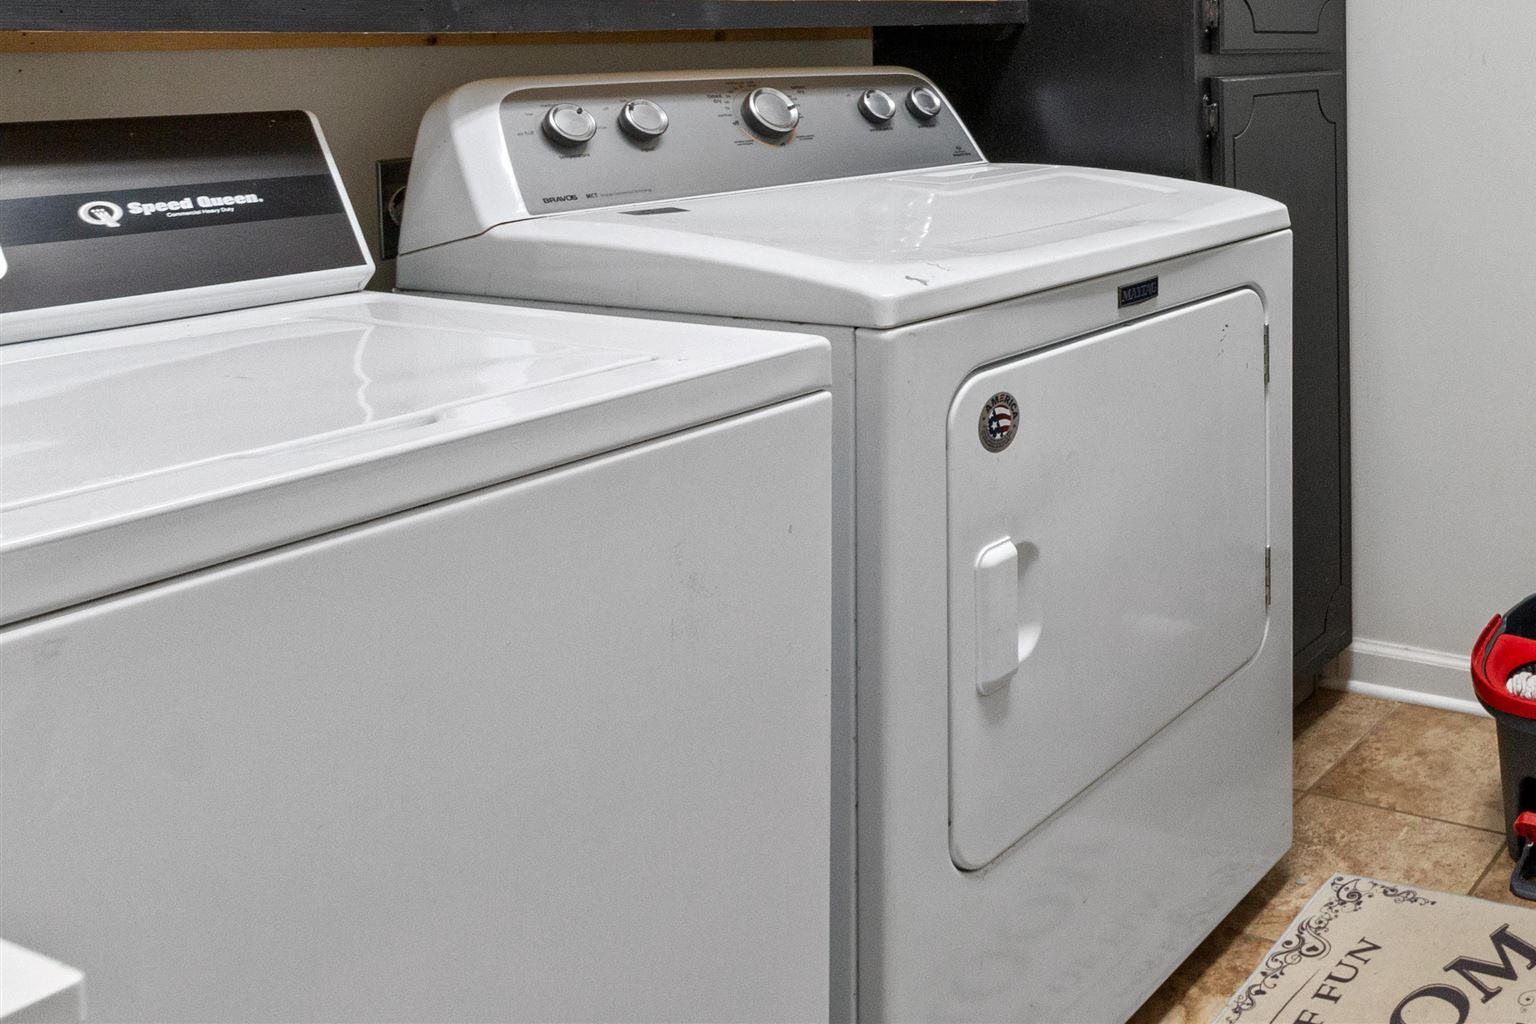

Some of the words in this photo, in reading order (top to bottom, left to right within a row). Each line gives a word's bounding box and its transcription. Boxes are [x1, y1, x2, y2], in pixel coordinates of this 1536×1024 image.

[126, 197, 194, 216] Speed
[542, 194, 578, 204] BRAVOS
[986, 393, 1018, 419] AMERICA
[1312, 936, 1382, 1005] FUN
